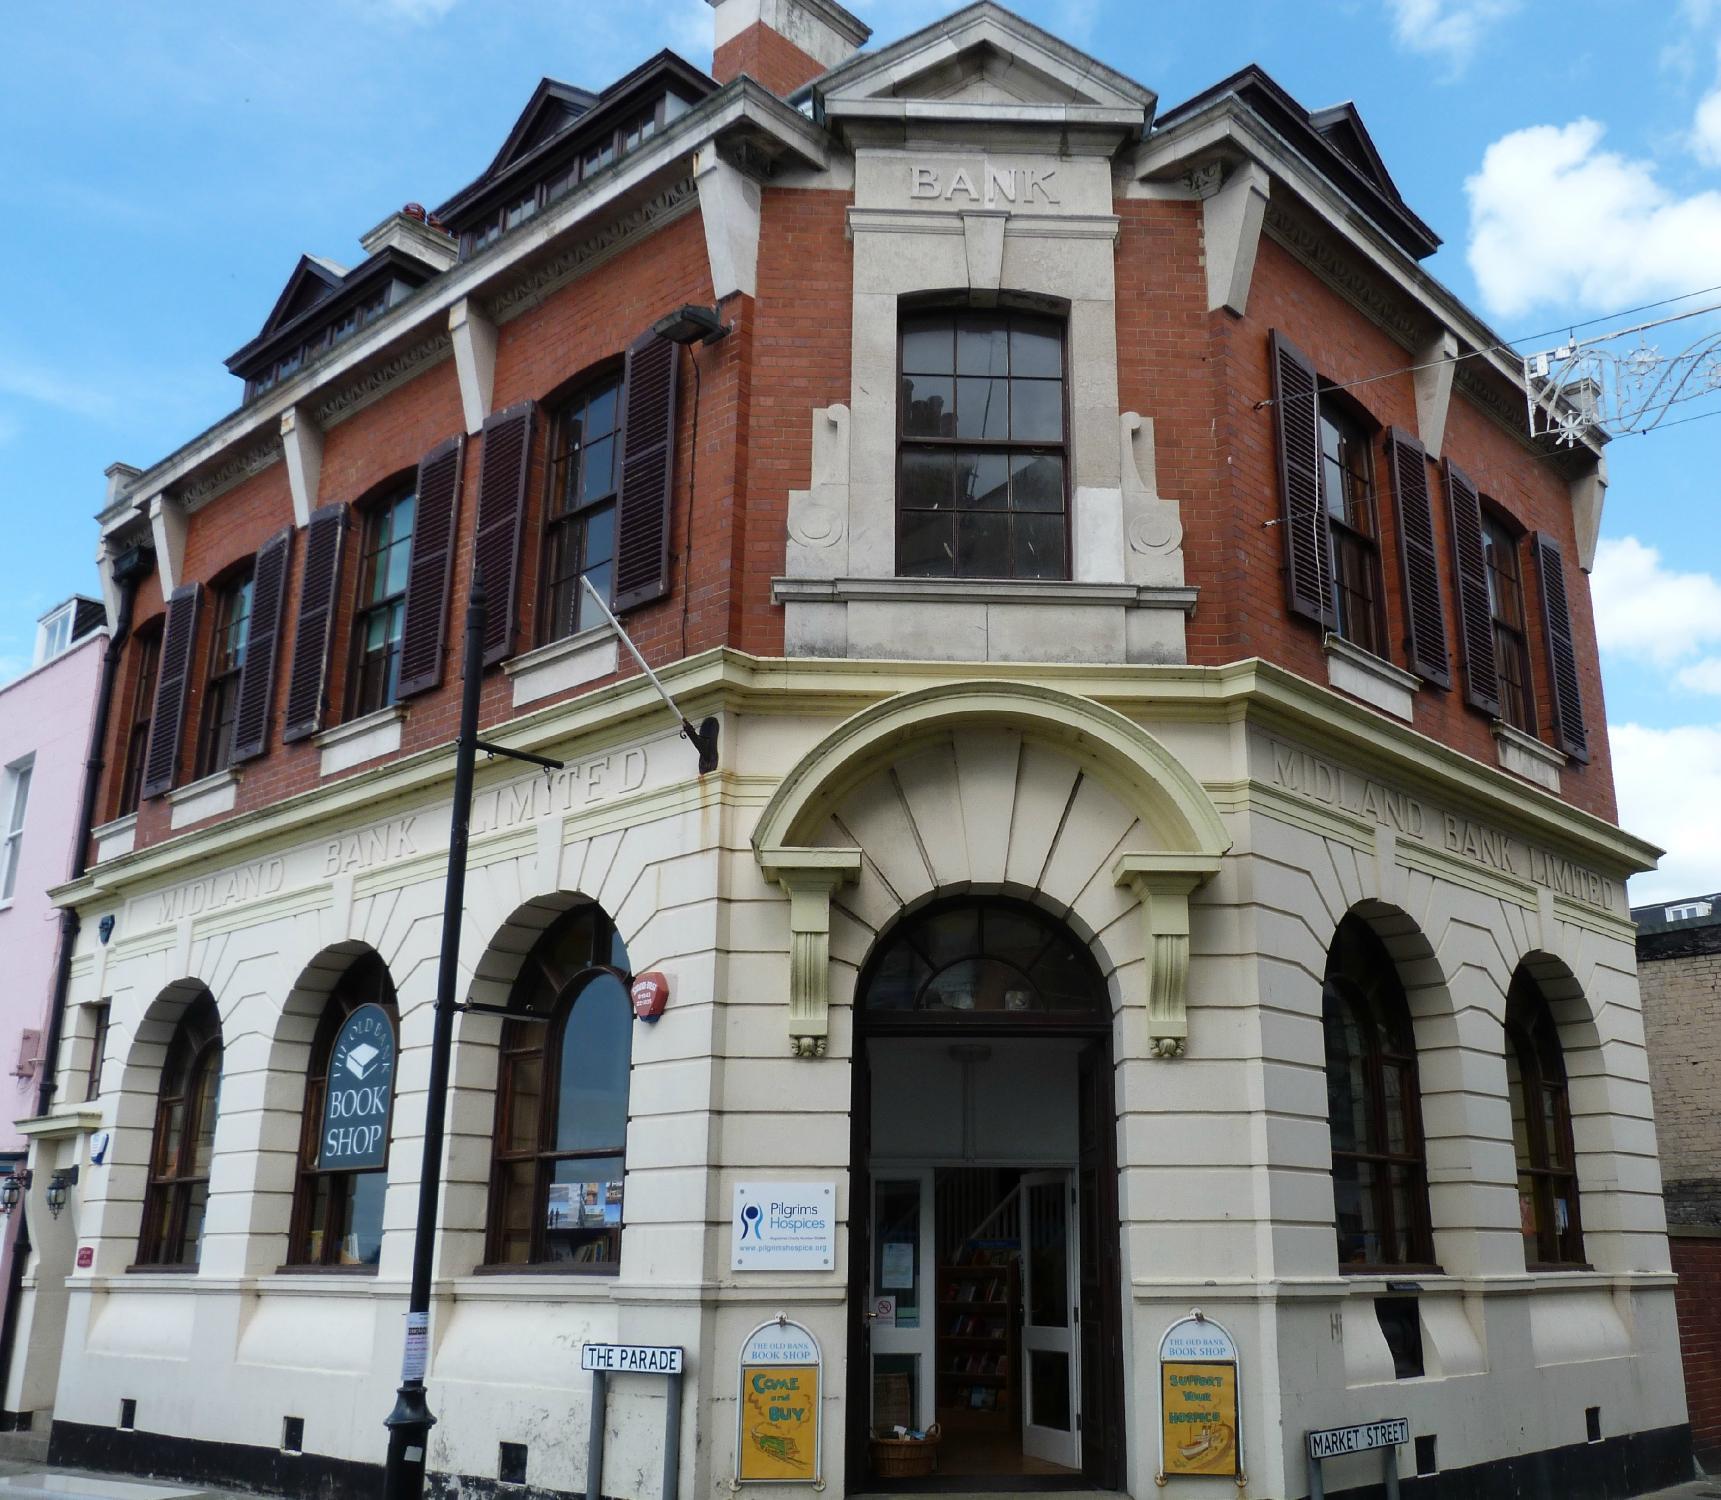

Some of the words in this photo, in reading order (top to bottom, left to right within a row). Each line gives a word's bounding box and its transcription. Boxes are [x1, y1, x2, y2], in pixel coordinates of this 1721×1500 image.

[910, 167, 1061, 204] BANK
[1270, 740, 1425, 840] MIDLAND
[1444, 810, 1517, 875] BANK
[1529, 847, 1614, 911] LIMITED
[155, 858, 286, 926] MIDLAND
[322, 816, 419, 878] BANK
[467, 746, 649, 836] LIMITED
[329, 1085, 388, 1119] BOOK
[325, 1125, 382, 1157] SHOP
[770, 1202, 818, 1218] Pilgrims
[770, 1217, 825, 1233] Hospices
[739, 1244, 827, 1253] www.pilgrimshospice.org
[1169, 1338, 1183, 1346] THE
[1185, 1338, 1201, 1346] OLD
[1202, 1338, 1224, 1346] BANK
[1169, 1347, 1197, 1356] BOOK
[1199, 1347, 1226, 1356] SHOP
[588, 1348, 614, 1367] THE
[619, 1349, 677, 1370] PARADE
[751, 1351, 780, 1360] BOOK
[783, 1351, 811, 1360] SHOP
[768, 1406, 805, 1422] BUY
[1313, 1429, 1360, 1456] MARKET
[1366, 1422, 1405, 1447] STREET
